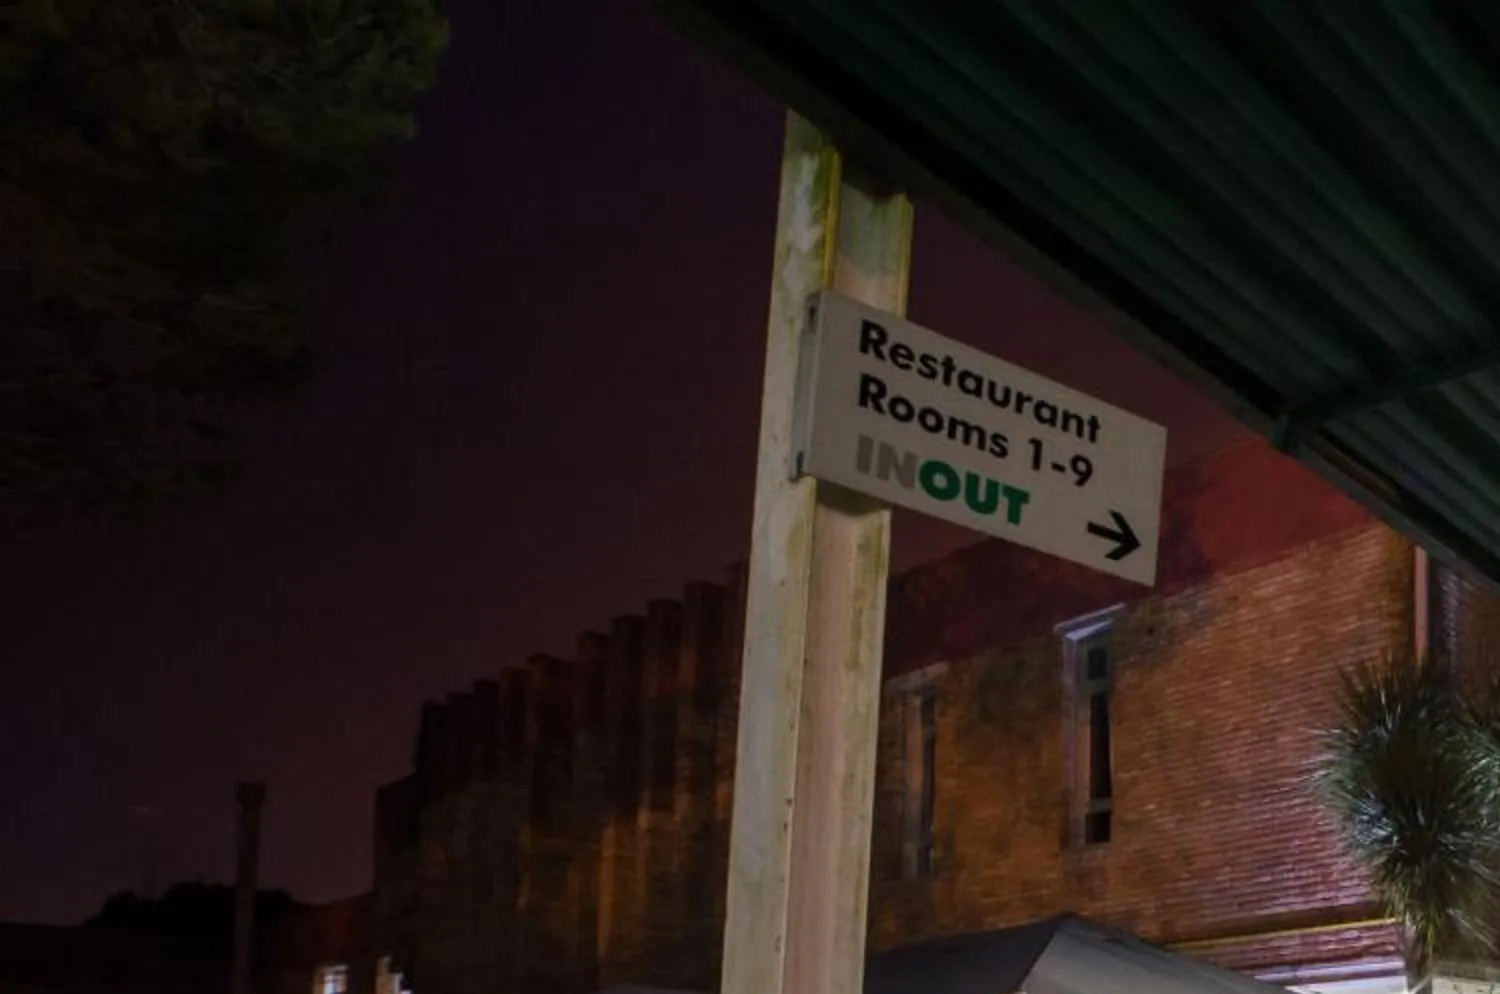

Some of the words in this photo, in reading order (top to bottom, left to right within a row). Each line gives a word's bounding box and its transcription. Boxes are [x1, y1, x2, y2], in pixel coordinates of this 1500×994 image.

[857, 372, 1010, 460] Rooms
[1026, 436, 1095, 489] 1-9
[858, 318, 1102, 444] Restaurant
[854, 433, 1031, 527] INOUT
